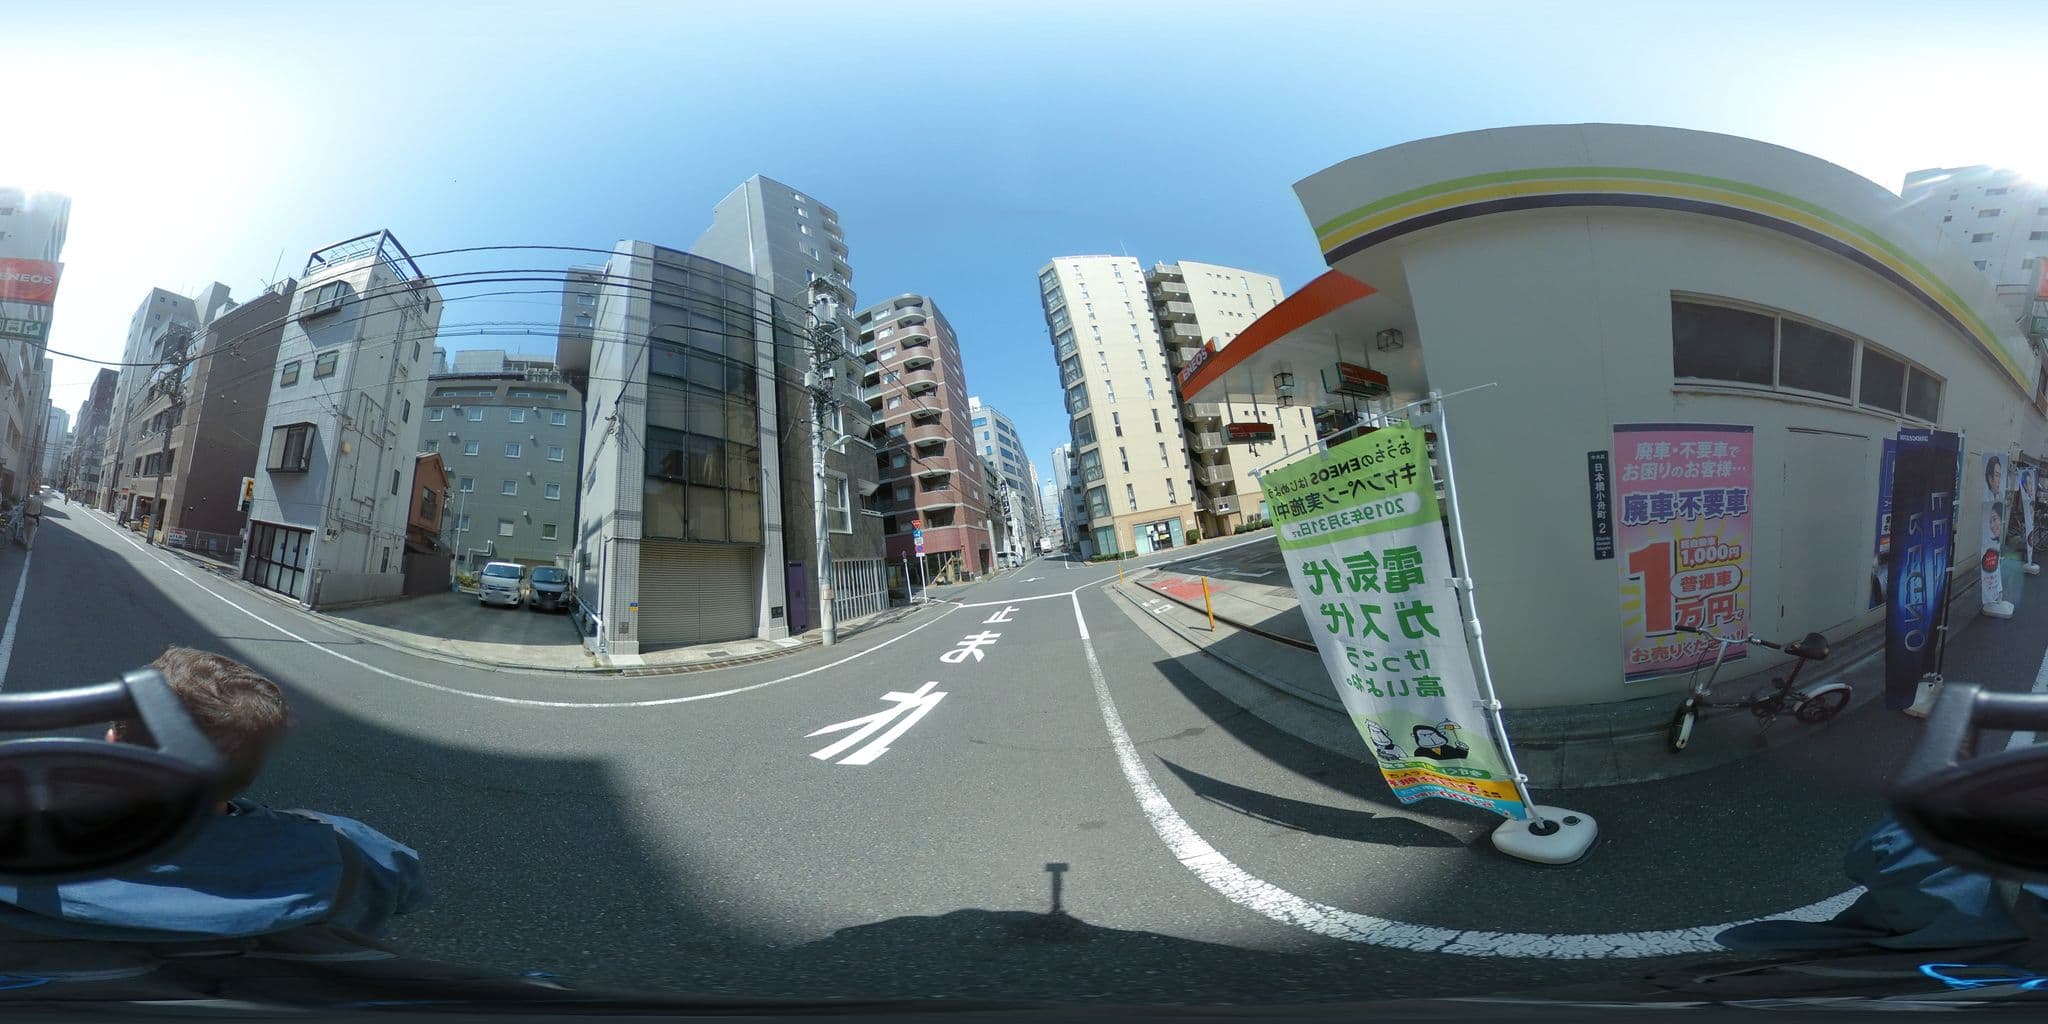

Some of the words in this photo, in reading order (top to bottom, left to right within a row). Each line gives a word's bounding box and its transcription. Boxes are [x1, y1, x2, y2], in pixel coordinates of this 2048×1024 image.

[1182, 348, 1208, 381] ENEOS
[1679, 570, 1733, 592] 普通車
[804, 606, 1020, 766] 止まれ
